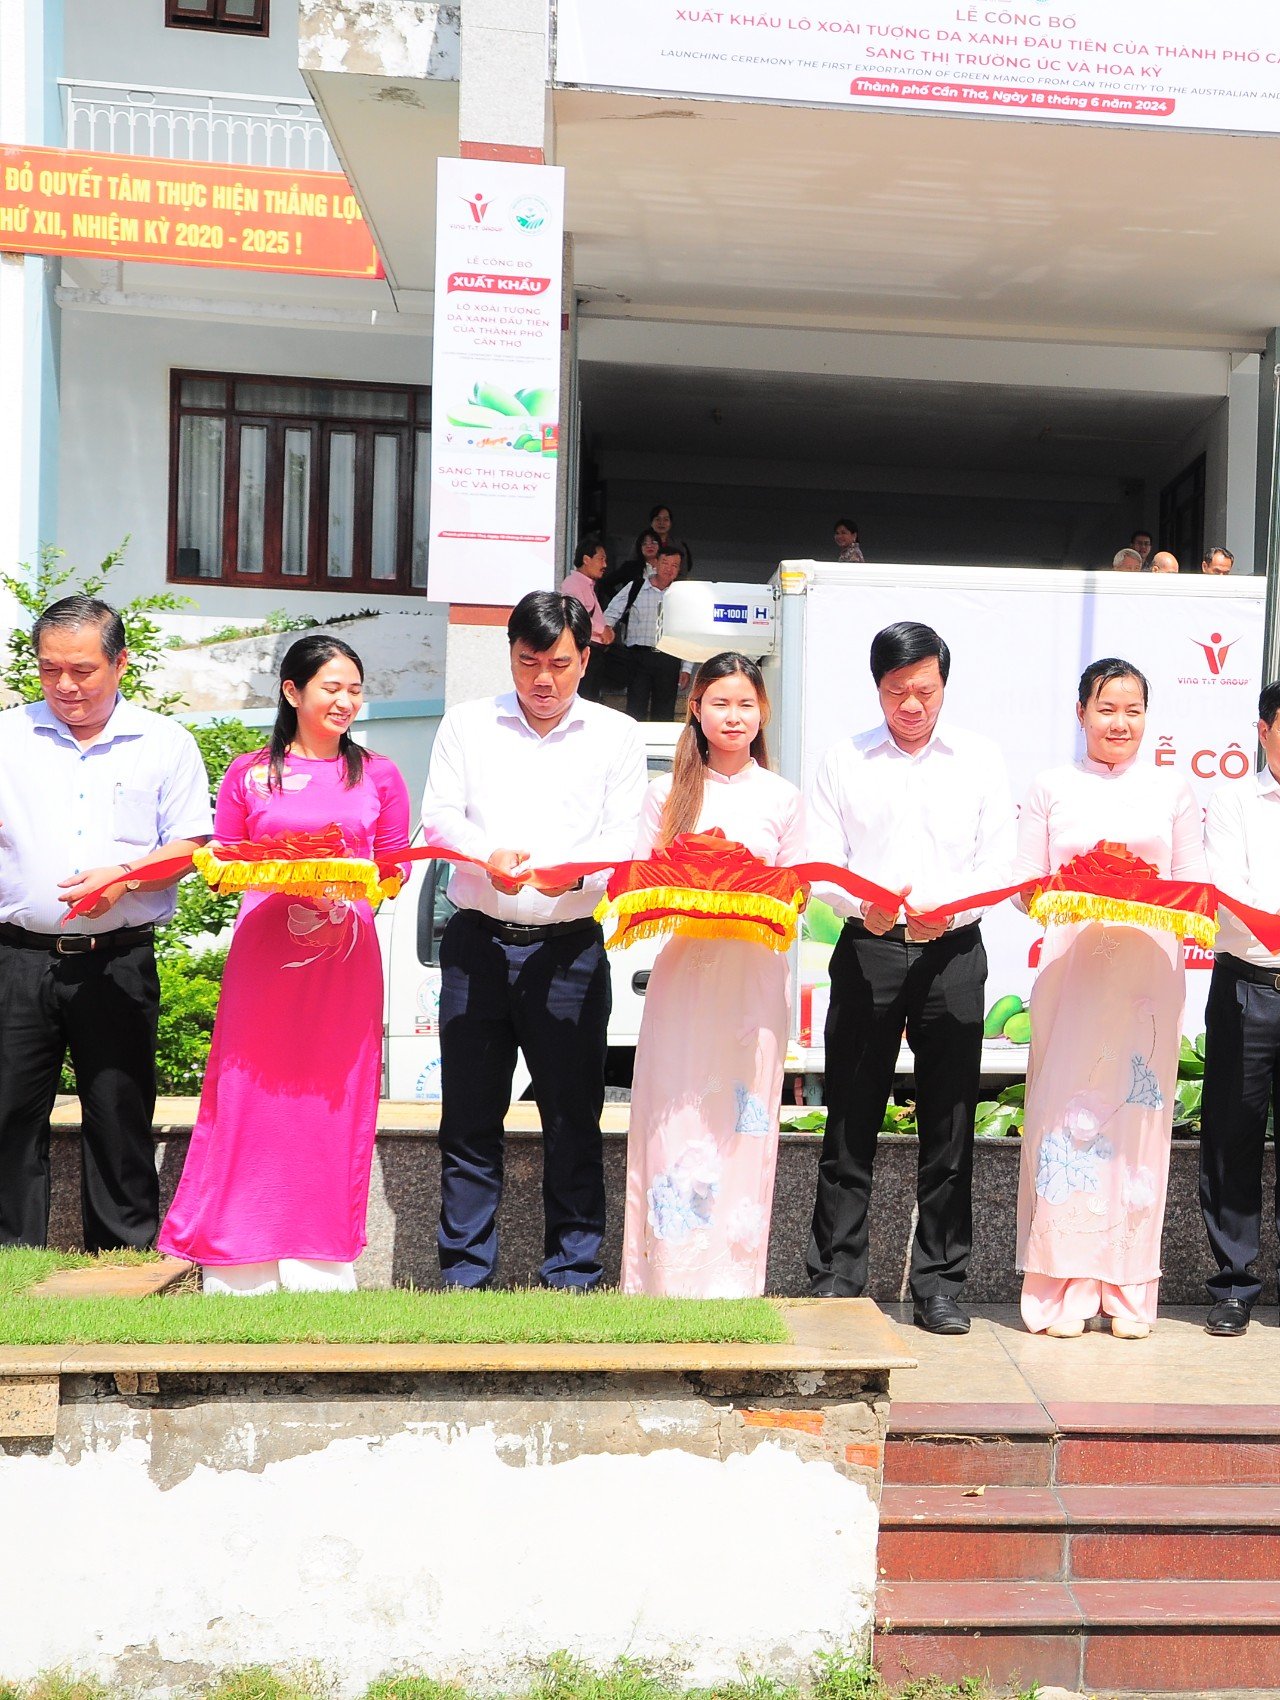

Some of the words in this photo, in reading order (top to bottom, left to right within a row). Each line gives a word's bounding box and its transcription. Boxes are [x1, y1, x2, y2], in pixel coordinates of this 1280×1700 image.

[956, 5, 977, 22] LỄ
[984, 10, 1041, 26] CÔNG
[1049, 14, 1076, 29] BỐ
[676, 9, 724, 23] XUẤT
[730, 14, 781, 28] KHẨU
[788, 17, 811, 30] LÔ
[817, 20, 860, 34] XOÀI
[866, 25, 930, 40] TƯỢNG
[937, 30, 962, 42] DA
[968, 33, 1017, 46] XANH
[1024, 34, 1062, 49] ĐẦU
[1068, 39, 1106, 52] TIÊN
[1113, 40, 1150, 56] CỦA
[1154, 45, 1216, 60] THÀNH
[1223, 50, 1260, 62] PHỐ
[661, 50, 727, 60] LAUNCHING
[731, 55, 794, 66] CEREMONY
[798, 60, 818, 68] THE
[822, 62, 852, 70] FIRST
[855, 64, 932, 76] EXPORTATION
[953, 72, 990, 80] GREEN
[993, 74, 1034, 83] MANGO
[1038, 77, 1069, 85] FROM
[1191, 88, 1257, 98] AUSTRALIAN
[866, 47, 914, 60] SANG
[920, 51, 949, 65] THỊ
[955, 53, 1031, 68] TRƯỜNG
[1037, 57, 1061, 71] ÚC
[1067, 60, 1090, 73] VÀ
[1097, 64, 1134, 76] HOA
[1141, 64, 1162, 77] KỲ
[856, 80, 899, 94] Thành
[902, 80, 929, 97] phố
[932, 83, 959, 97] Cần
[962, 85, 990, 100] Thơ,
[992, 90, 1027, 105] Ngày
[1031, 92, 1044, 103] 18
[1047, 92, 1087, 109] tháng
[1091, 97, 1099, 107] 6
[1102, 98, 1131, 110] năm
[1135, 100, 1167, 111] 2024
[5, 161, 33, 192] ĐỎ
[39, 167, 103, 198] QUYẾT
[108, 173, 151, 203] TÂM
[156, 181, 207, 211] THỰC
[212, 183, 259, 216] HIỆN
[264, 183, 328, 217] THẮNG
[33, 210, 66, 239] XII,
[73, 212, 139, 245] NHIỆM
[144, 216, 170, 244] KỲ
[175, 223, 223, 249] 2020
[242, 228, 289, 254] 2025
[296, 232, 302, 255] !
[453, 275, 495, 288] XUẤT
[498, 277, 541, 292] KHẨU
[466, 315, 496, 324] XANH
[438, 466, 472, 475] SANG
[493, 483, 519, 491] HOA
[1155, 736, 1176, 767] Ễ
